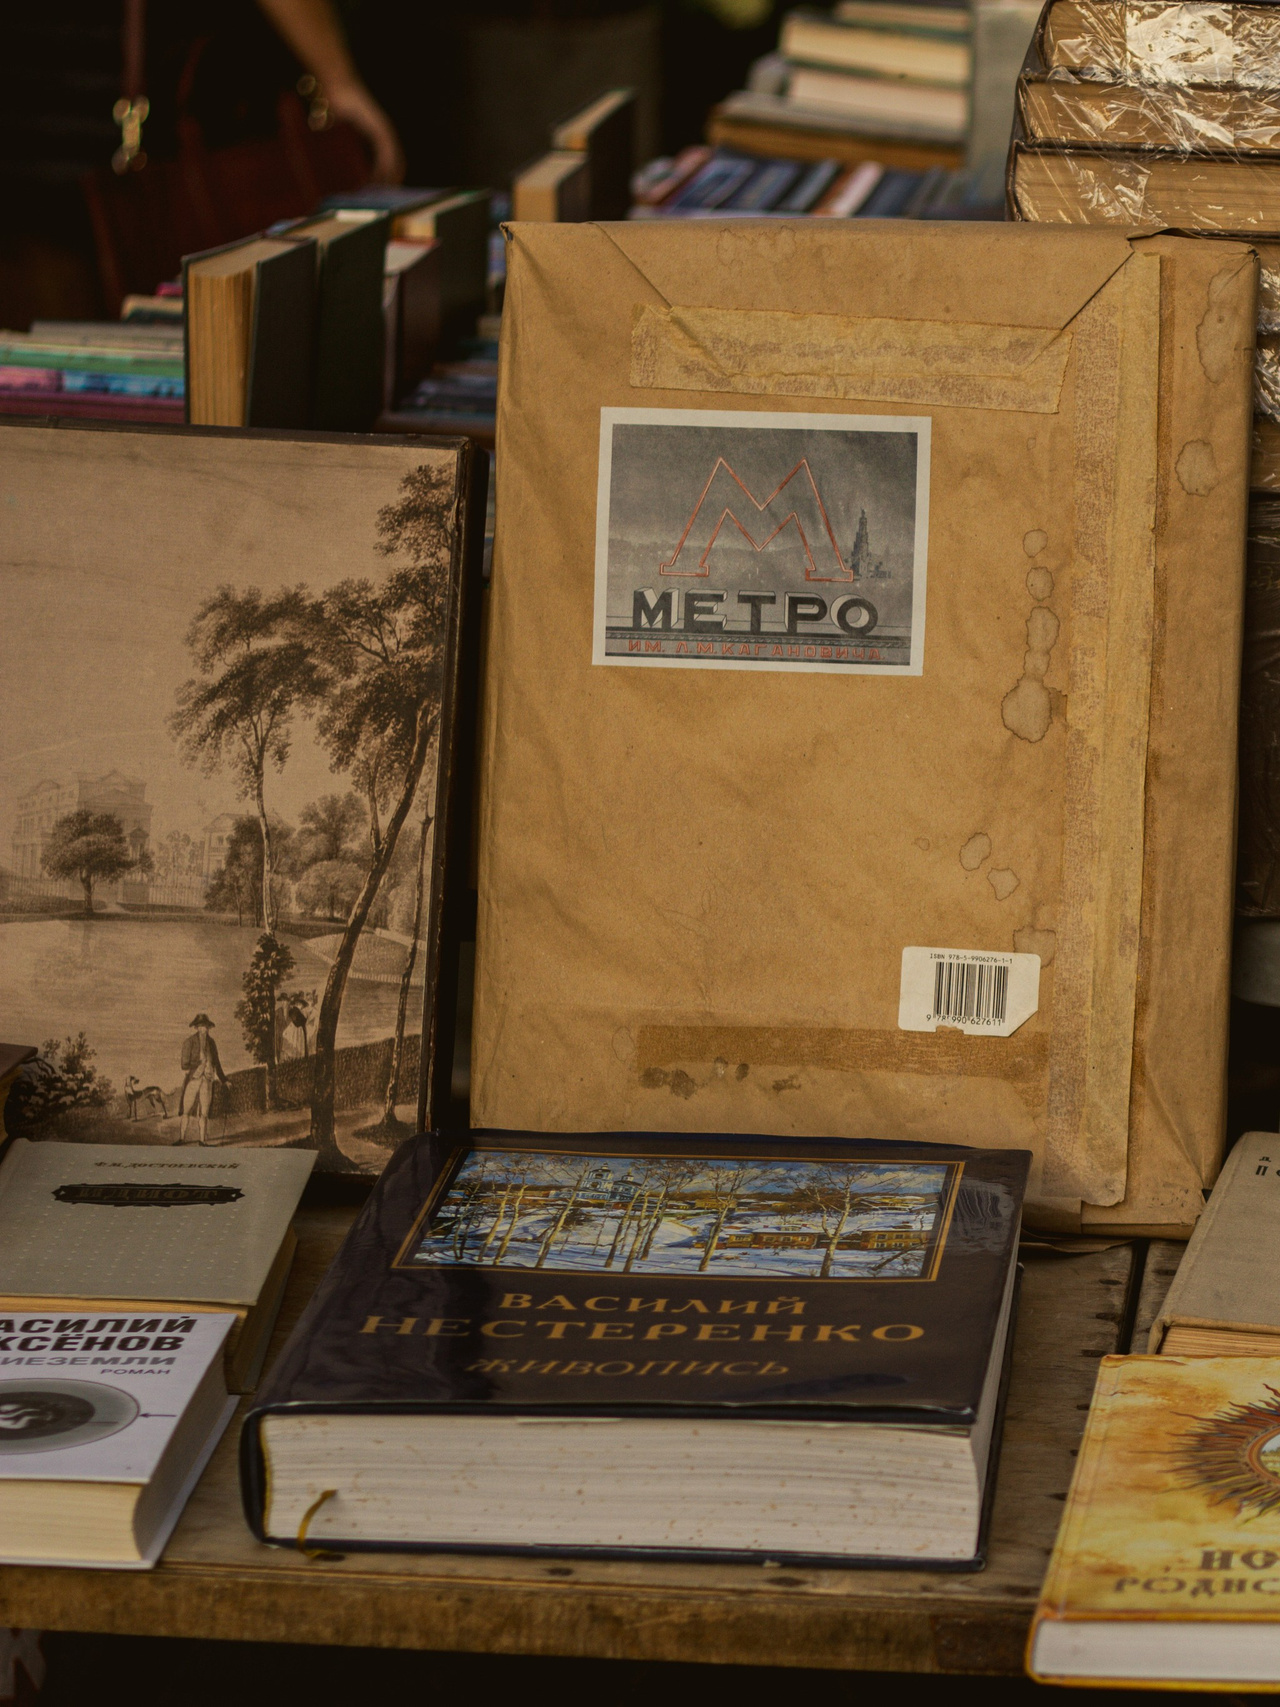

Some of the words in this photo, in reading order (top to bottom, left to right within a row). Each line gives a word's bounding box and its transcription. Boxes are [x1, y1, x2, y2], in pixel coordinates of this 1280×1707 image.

[632, 587, 879, 637] МЕТРО
[628, 639, 665, 653] ИМ.
[948, 954, 1013, 964] 978-5-9906276-1-1
[79, 1188, 219, 1201] ИДИОТ
[498, 1292, 809, 1316] ВАСИЛИЙ
[358, 1315, 926, 1343] НЕСТЕРЕНКО
[99, 1368, 172, 1376] РОМАН
[462, 1357, 791, 1378] ЖИВОПИСЬ
